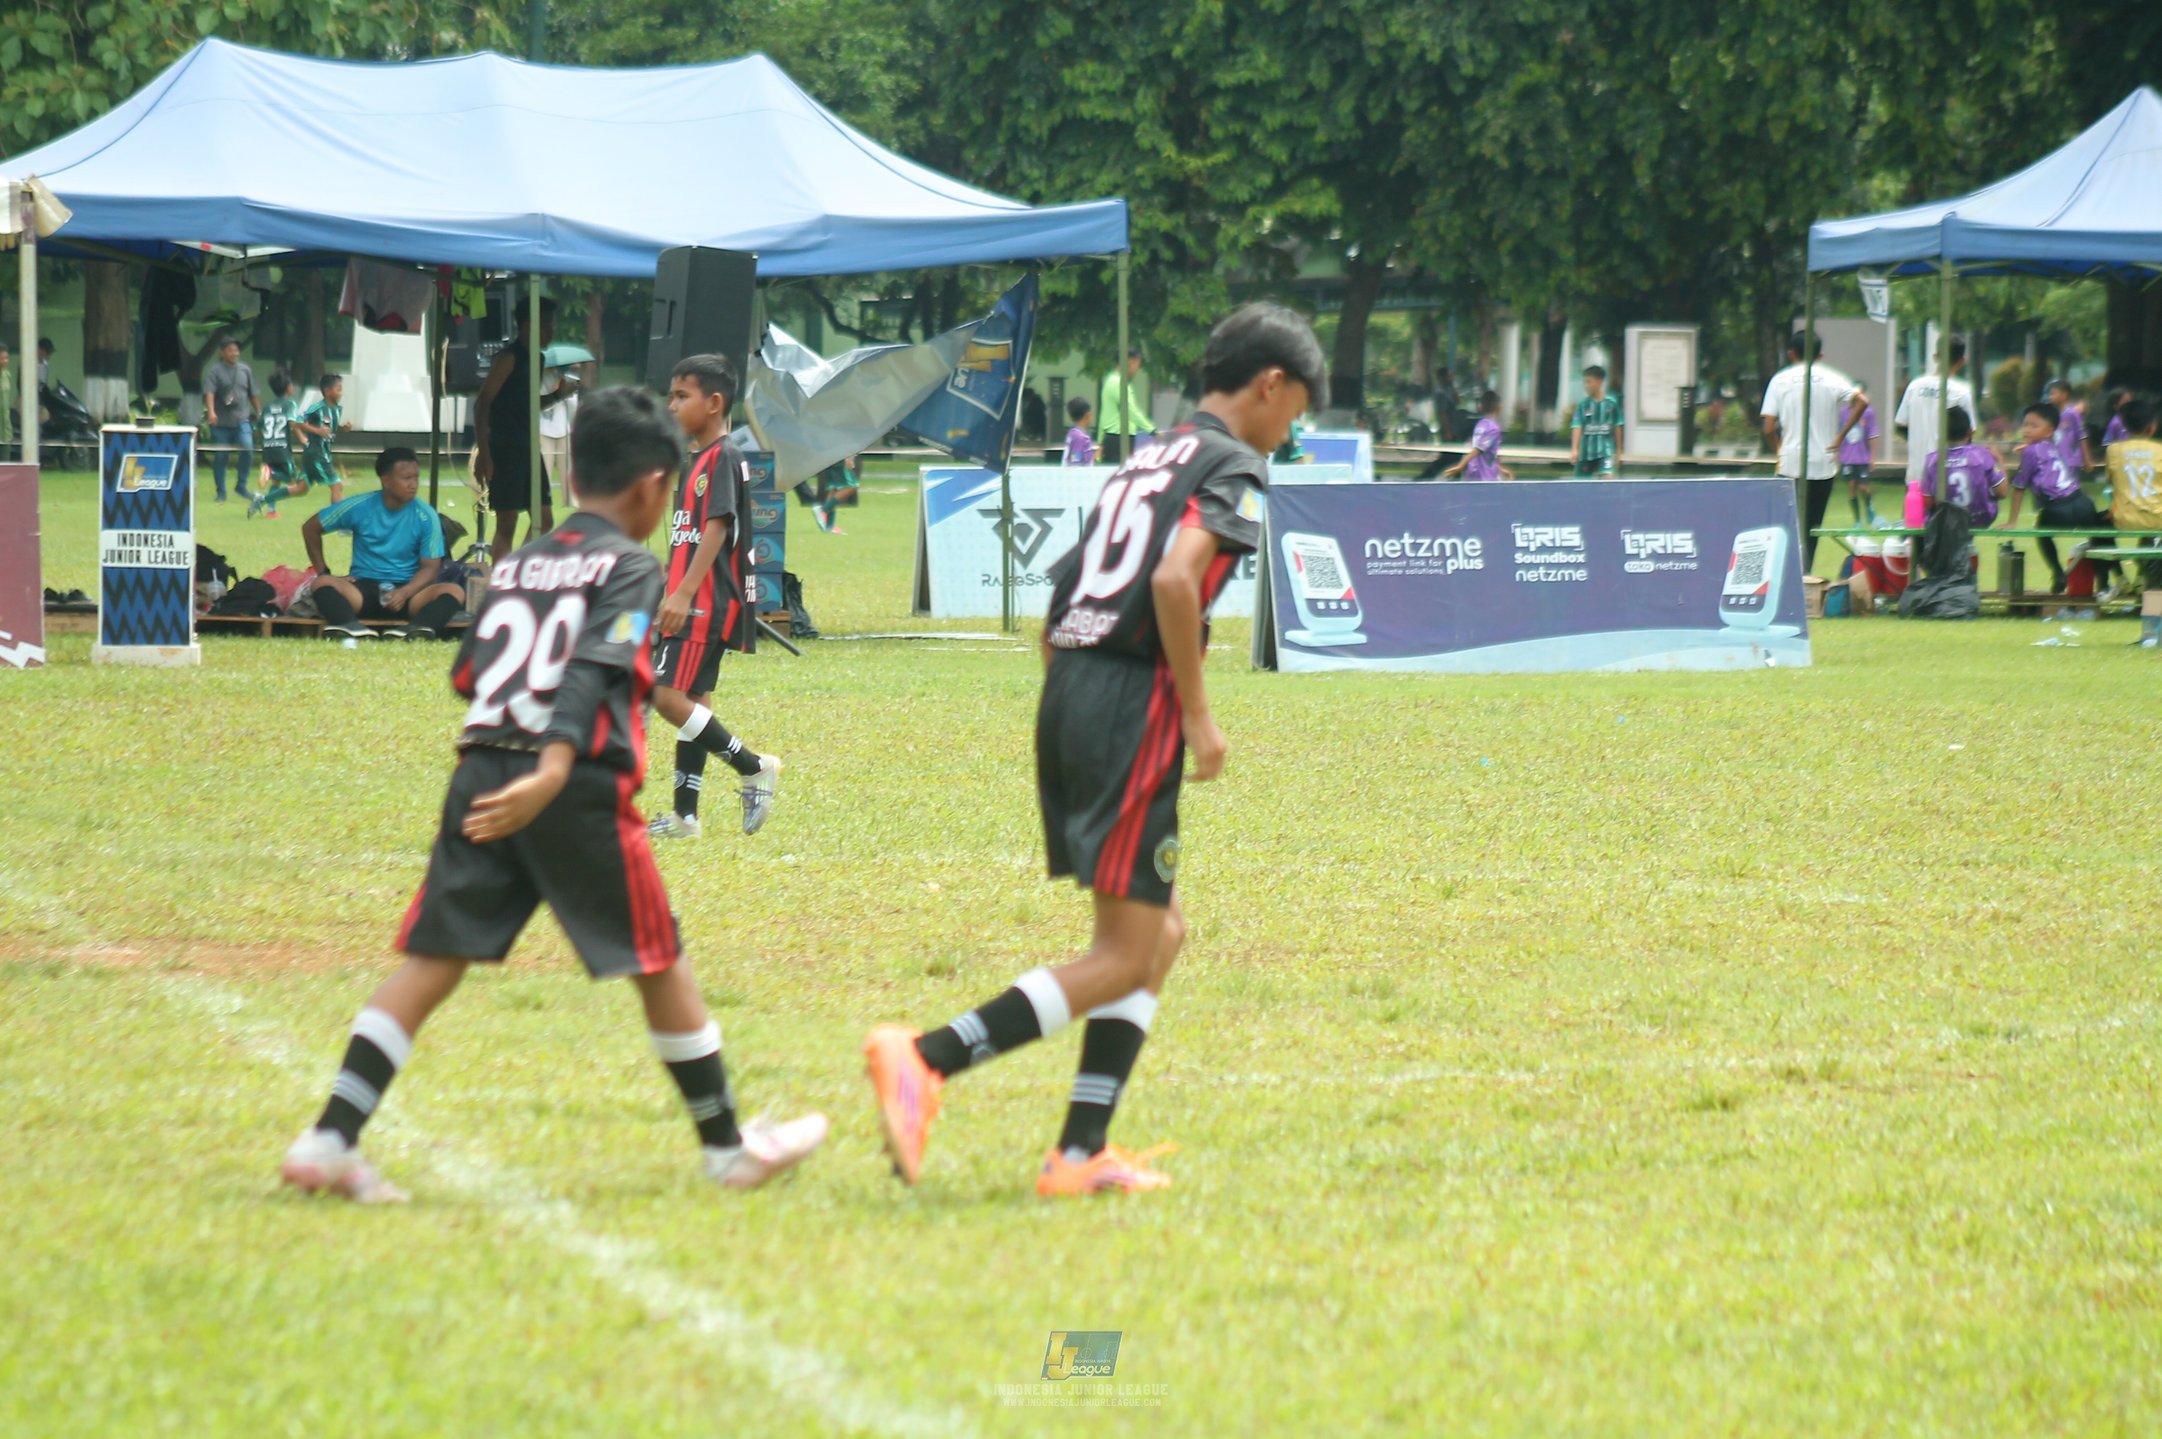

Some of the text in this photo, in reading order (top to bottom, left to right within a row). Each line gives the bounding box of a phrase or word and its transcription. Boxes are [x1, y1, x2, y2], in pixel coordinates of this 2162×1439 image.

[263, 415, 287, 439] 32
[2052, 460, 2074, 490] 2
[2122, 463, 2157, 498] 12
[1948, 471, 1971, 507] 3
[117, 532, 175, 548] INDONESIA
[1069, 468, 1174, 605] 15
[1364, 532, 1482, 558] netzme
[1515, 527, 1581, 551] QRIS
[1624, 533, 1693, 558] QRIS
[102, 549, 190, 565] JUNIOR LEAGUE
[1366, 558, 1485, 575] payment link for plus
[1514, 552, 1586, 564] Soundbox
[1655, 560, 1697, 571] netzme
[1515, 566, 1588, 582] netzme
[465, 595, 587, 734] 20
